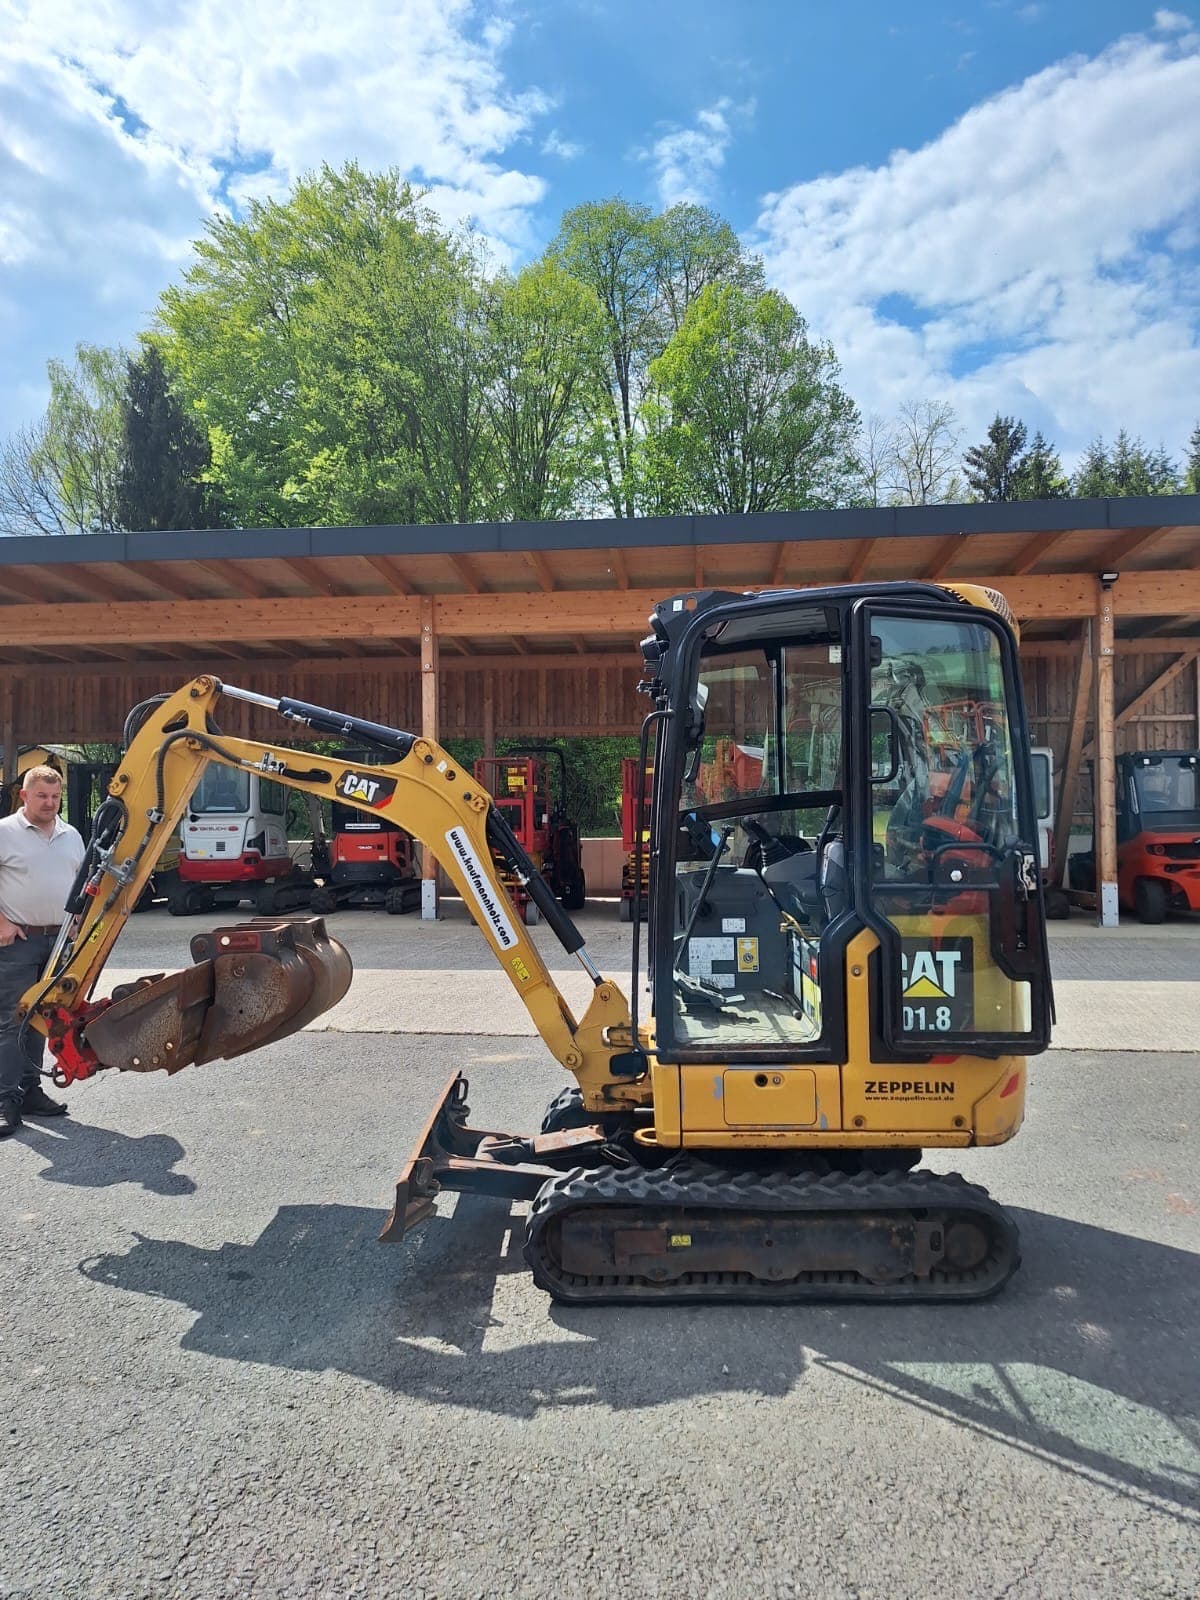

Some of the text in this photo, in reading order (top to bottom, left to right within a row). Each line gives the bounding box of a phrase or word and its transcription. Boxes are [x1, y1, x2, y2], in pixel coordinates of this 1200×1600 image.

[343, 774, 380, 803] CAT
[450, 830, 511, 946] www.kaufmannholz.com
[901, 951, 961, 998] AT
[864, 1081, 955, 1094] ZEPPELIN
